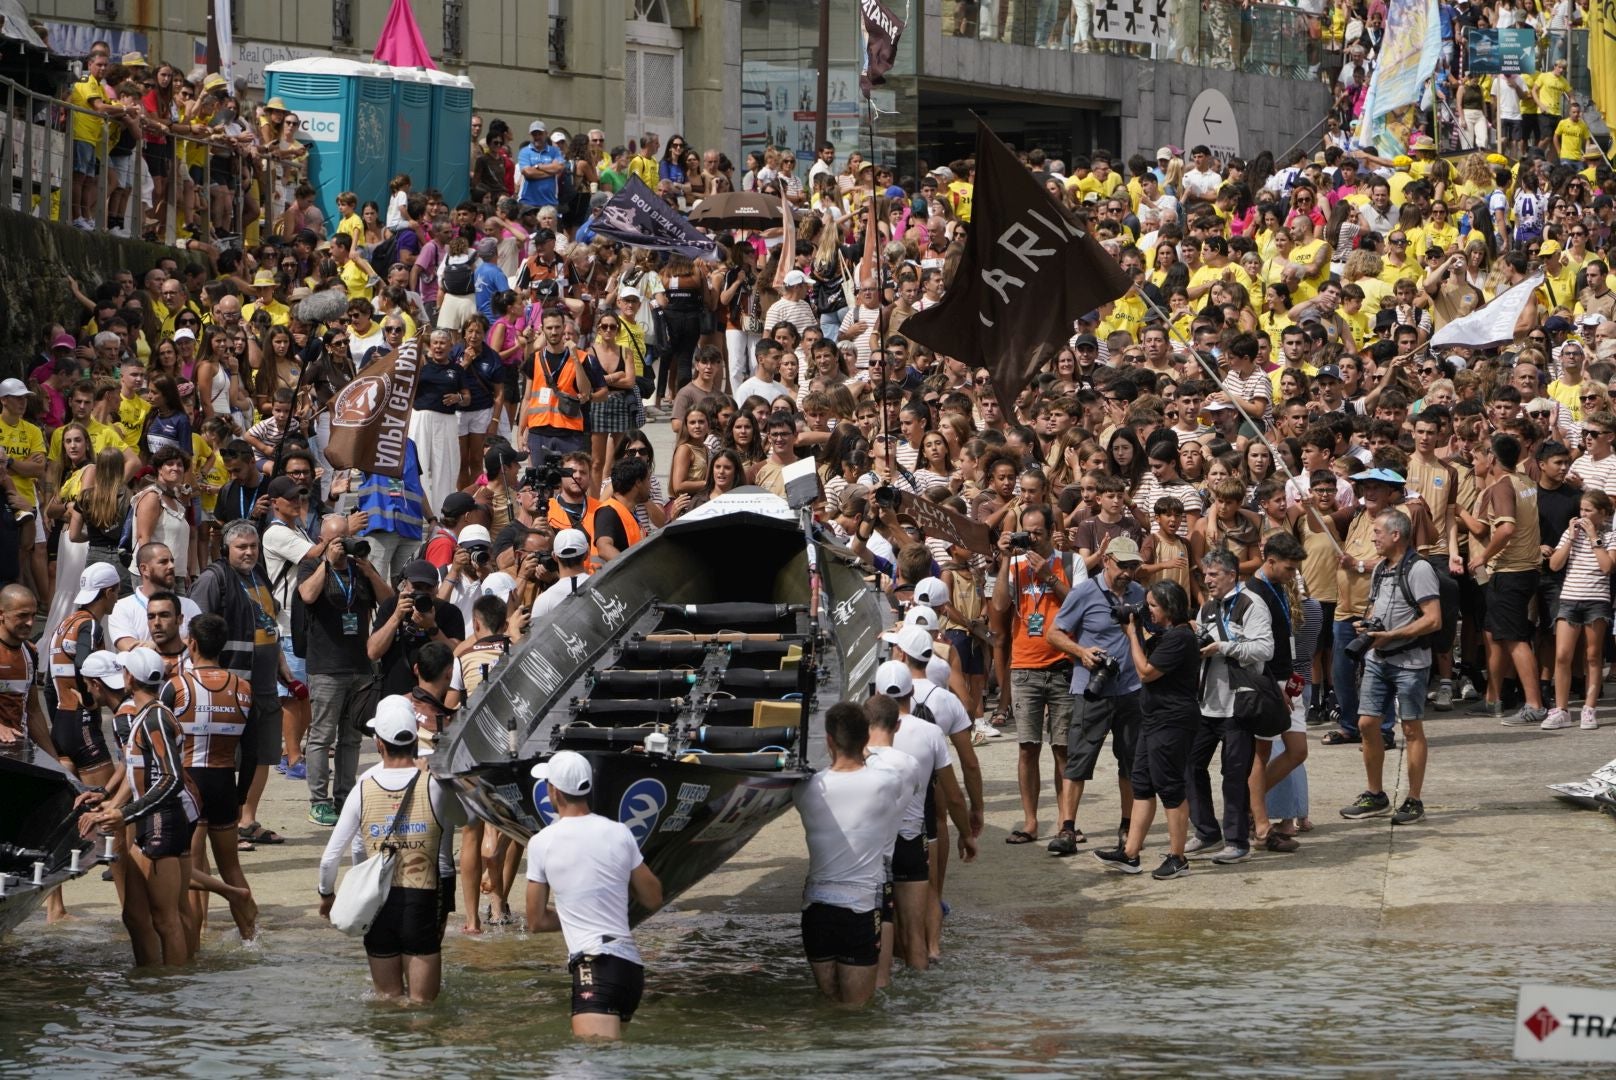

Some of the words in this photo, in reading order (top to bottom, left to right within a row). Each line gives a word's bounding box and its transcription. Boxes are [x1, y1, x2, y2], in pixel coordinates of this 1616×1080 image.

[239, 45, 260, 62] Real
[262, 47, 285, 63] Club
[247, 68, 259, 84] de
[311, 117, 335, 133] loc
[630, 193, 652, 213] BOU
[649, 209, 686, 241] BIZKAIA
